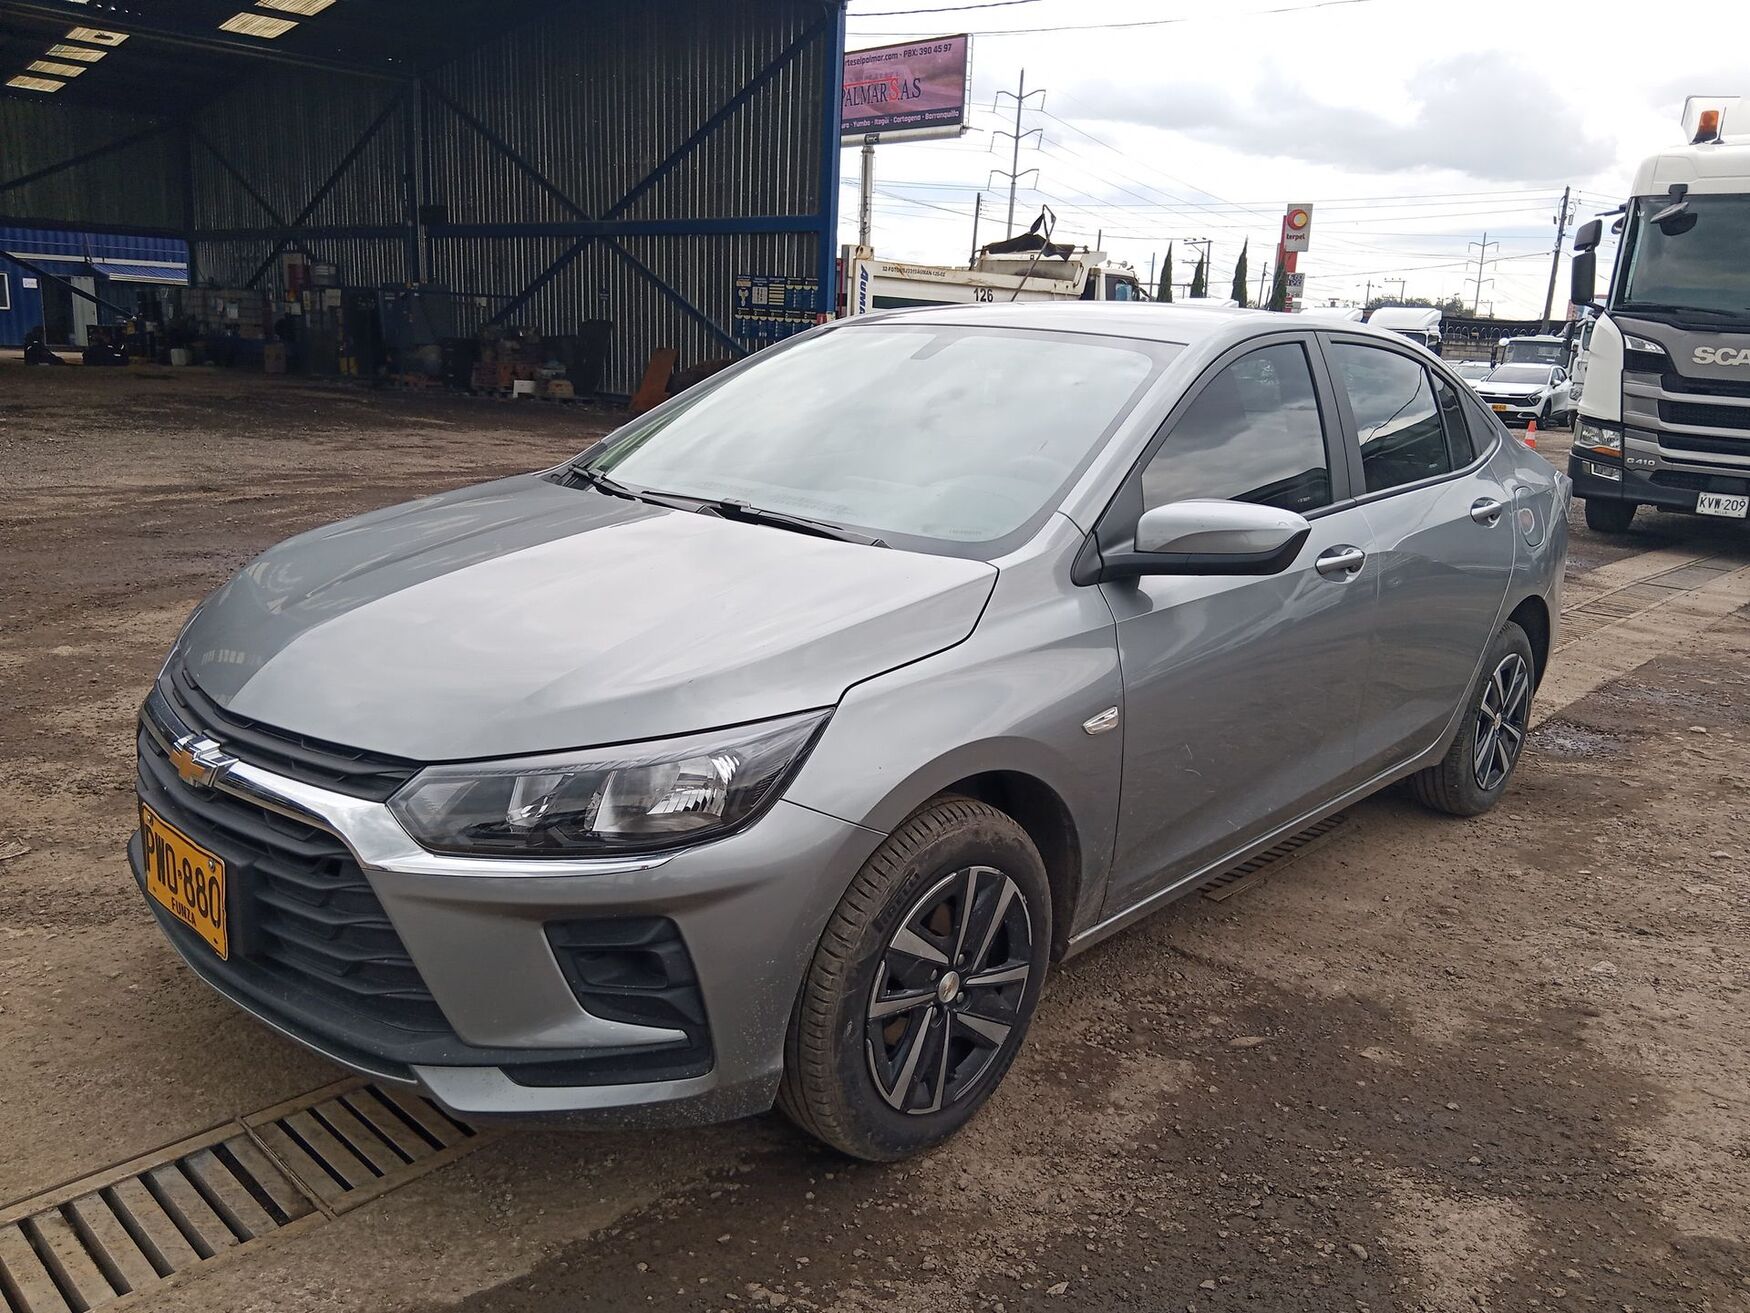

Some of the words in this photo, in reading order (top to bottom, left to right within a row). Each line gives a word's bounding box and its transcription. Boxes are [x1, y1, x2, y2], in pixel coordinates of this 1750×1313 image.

[919, 46, 932, 56] 390
[933, 45, 942, 54] 45
[943, 43, 952, 52] 97
[1286, 233, 1305, 241] terpel
[973, 287, 994, 303] 126
[171, 896, 197, 927] FUNZA
